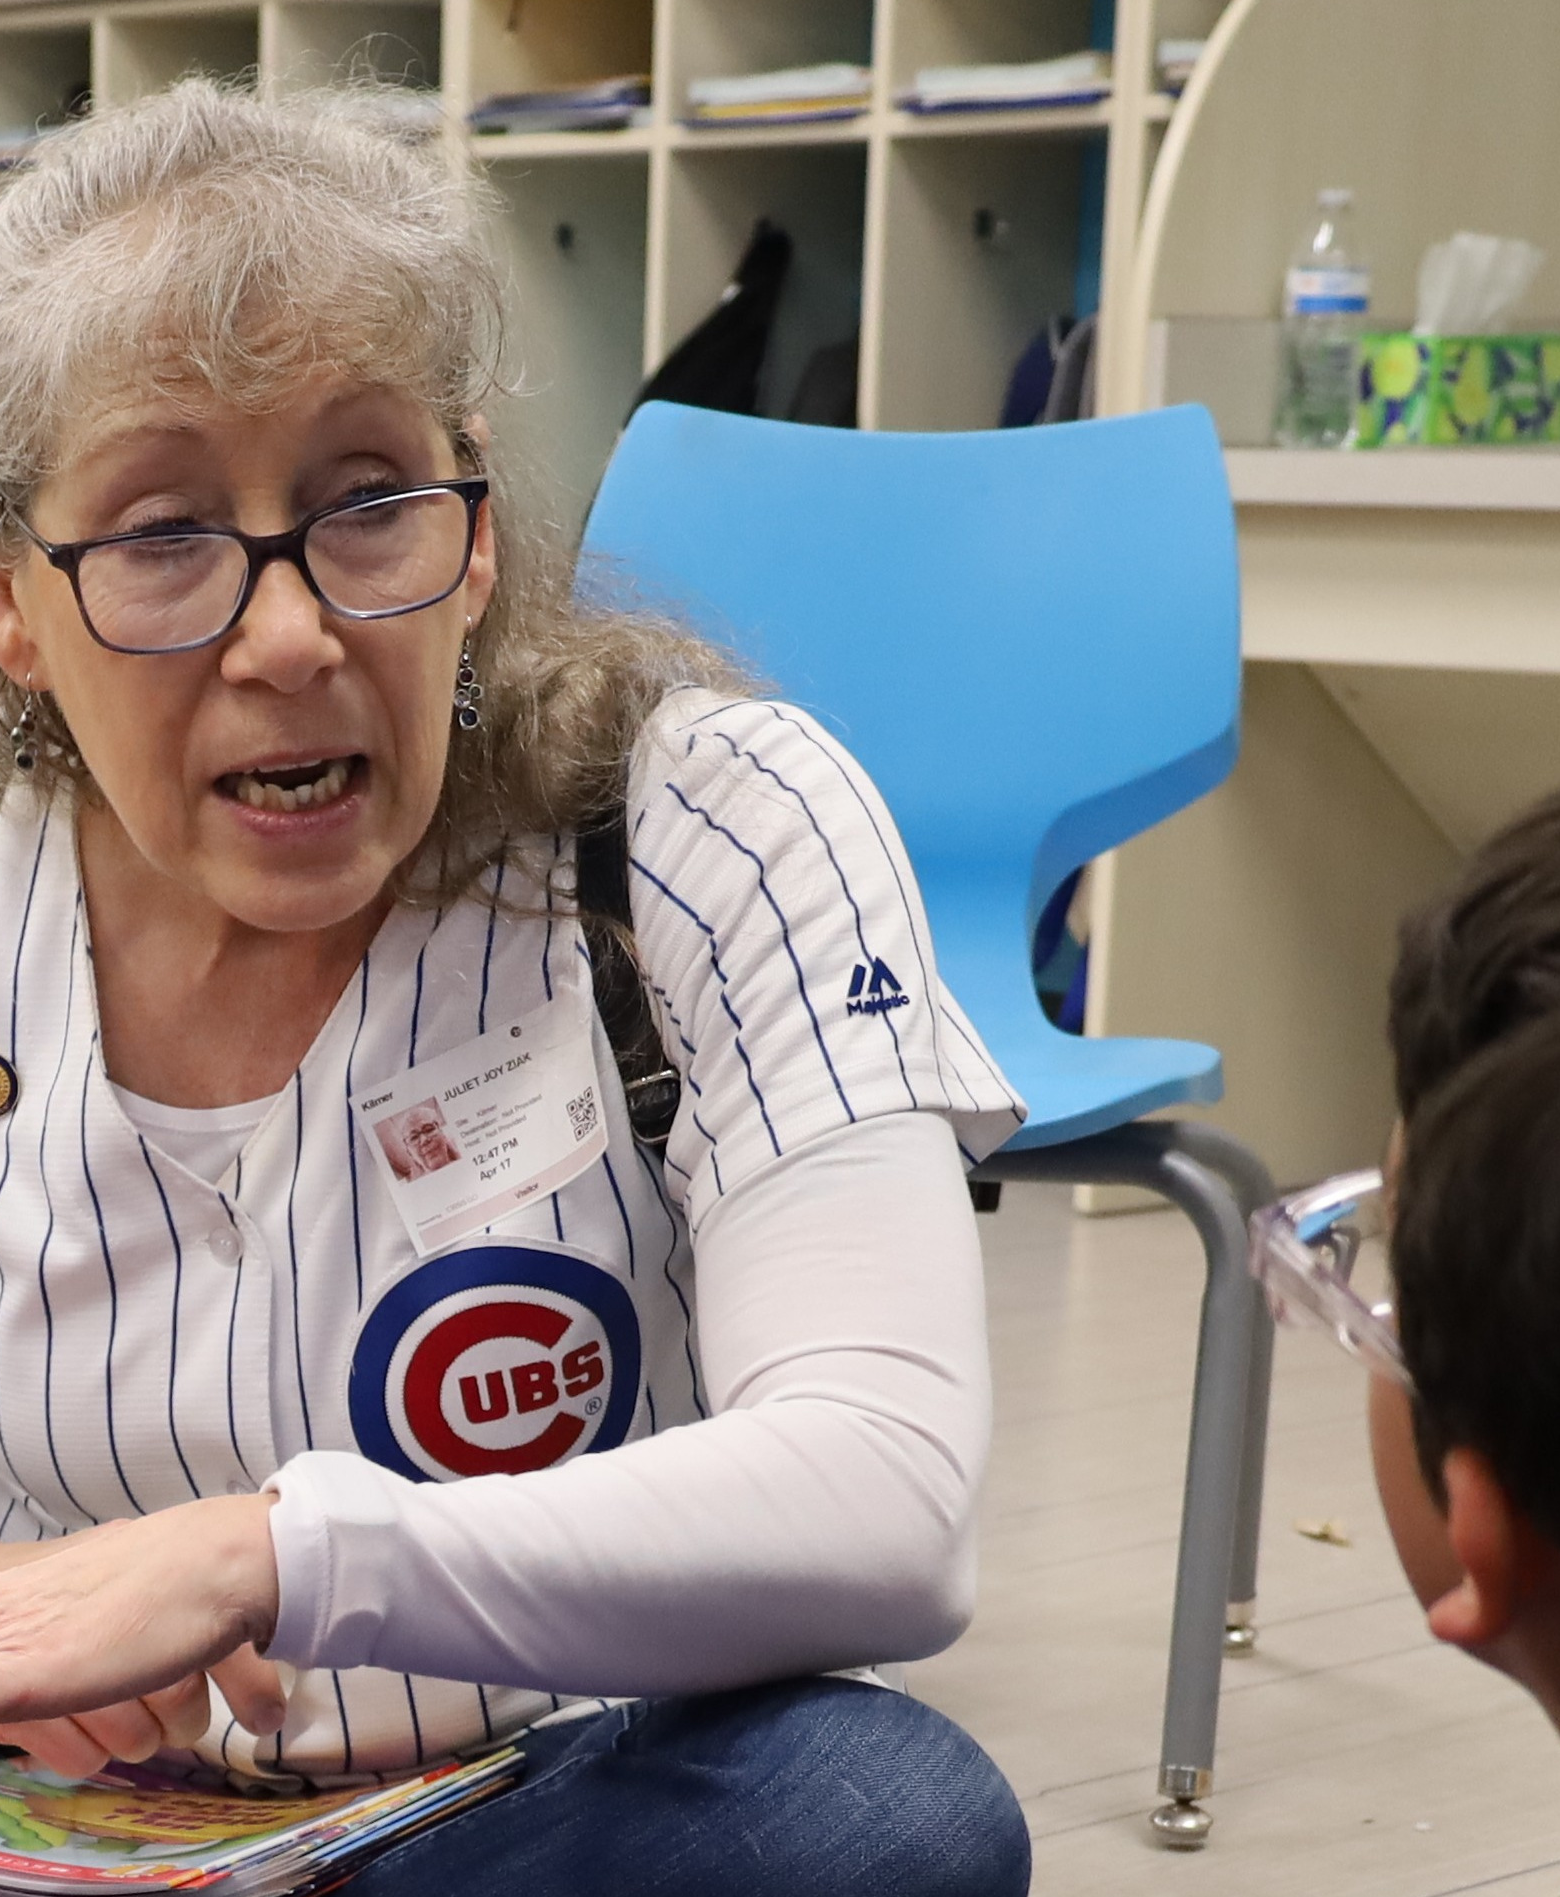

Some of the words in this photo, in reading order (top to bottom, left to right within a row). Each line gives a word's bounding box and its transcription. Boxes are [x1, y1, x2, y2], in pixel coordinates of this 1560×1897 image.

[846, 993, 910, 1018] Majestic
[443, 1077, 480, 1101] JULIET
[483, 1065, 504, 1083] JOY
[505, 1052, 532, 1072] ZIAK
[361, 1091, 393, 1112] Kilmer
[472, 1146, 499, 1166] 12:47
[502, 1137, 519, 1153] PM
[479, 1166, 498, 1181] Apr
[500, 1157, 511, 1170] 17
